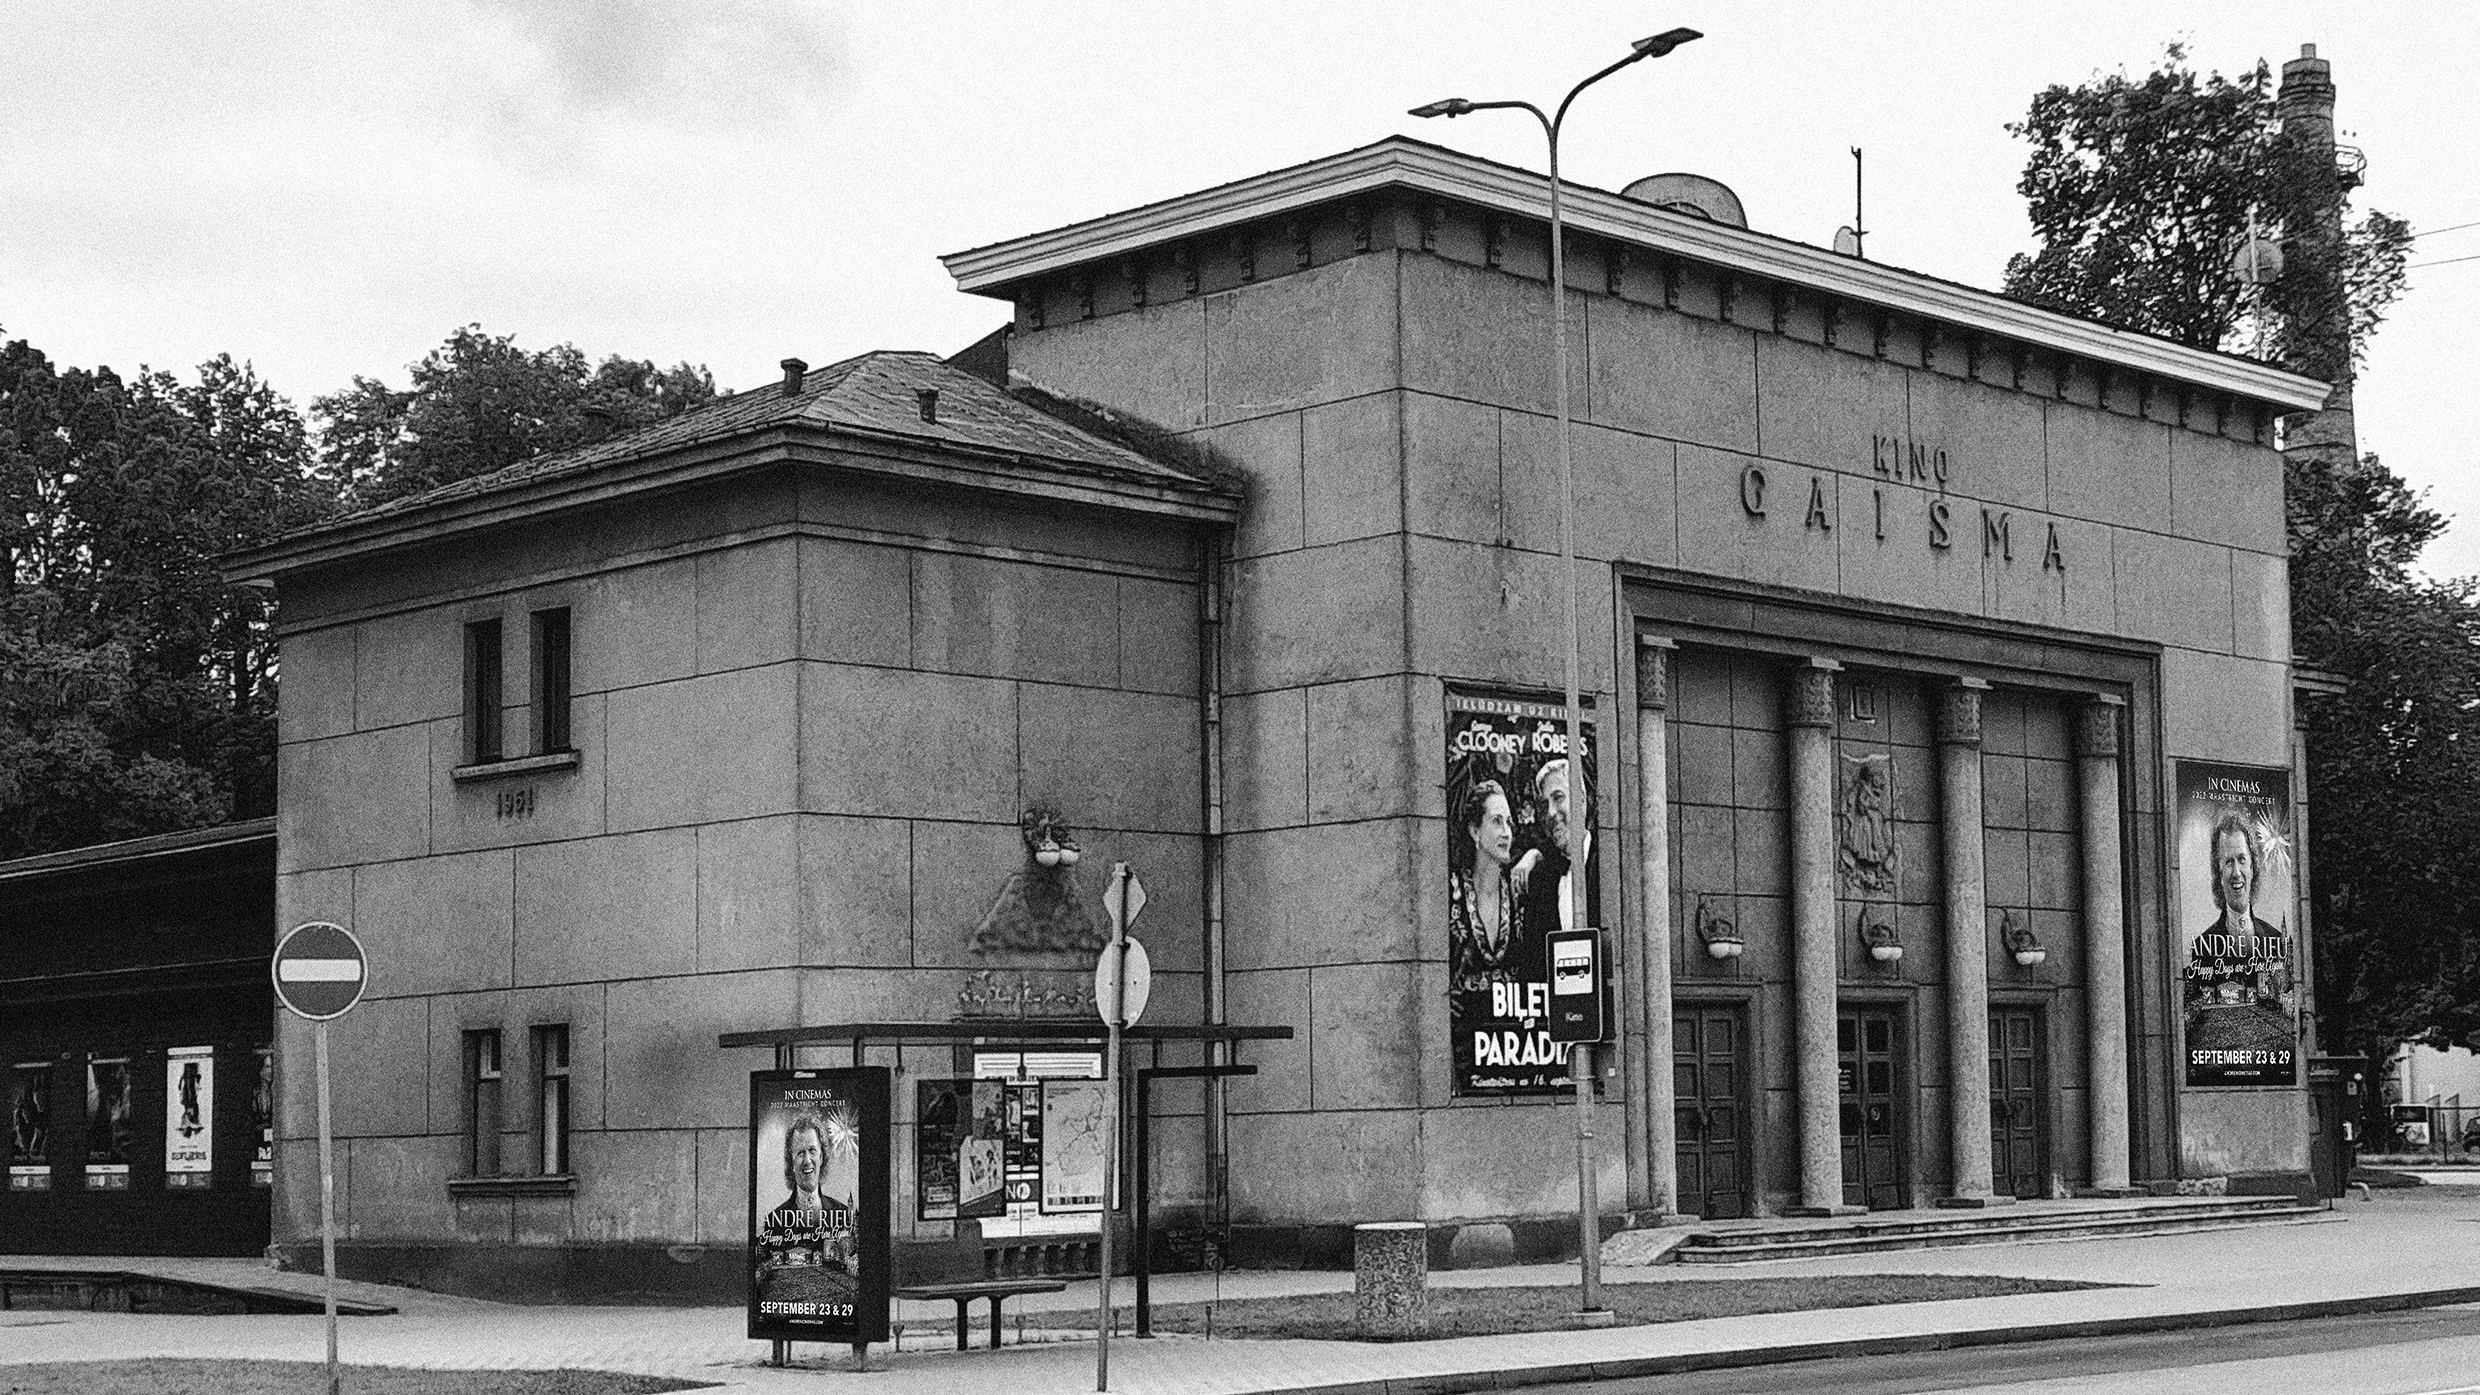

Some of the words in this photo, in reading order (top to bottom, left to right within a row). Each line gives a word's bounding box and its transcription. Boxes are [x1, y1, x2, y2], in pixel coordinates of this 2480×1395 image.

[1873, 434, 1947, 483] KINO
[1739, 464, 2066, 572] GAISMA
[1457, 730, 1526, 755] CLOONEY
[1532, 732, 1588, 757] ROBES
[2208, 777, 2218, 790] IN
[2220, 778, 2260, 794] CINEMAS
[2251, 935, 2287, 960] RIEU
[2187, 959, 2214, 980] Happy
[1492, 982, 1549, 1022] BIĻET
[1475, 1031, 1567, 1066] PARAD
[2192, 1050, 2252, 1065] SEPTEMBER
[2255, 1050, 2267, 1065] 23
[2269, 1052, 2277, 1065] &
[2278, 1050, 2290, 1065] 29
[784, 1090, 794, 1100] IN
[795, 1089, 832, 1100] CINEMAS
[819, 1209, 854, 1229] RIEU
[760, 1230, 783, 1246] Happy
[760, 1301, 816, 1315] SEPTEMBER
[819, 1303, 831, 1316] 23
[832, 1305, 840, 1316] &
[841, 1304, 854, 1317] 29
